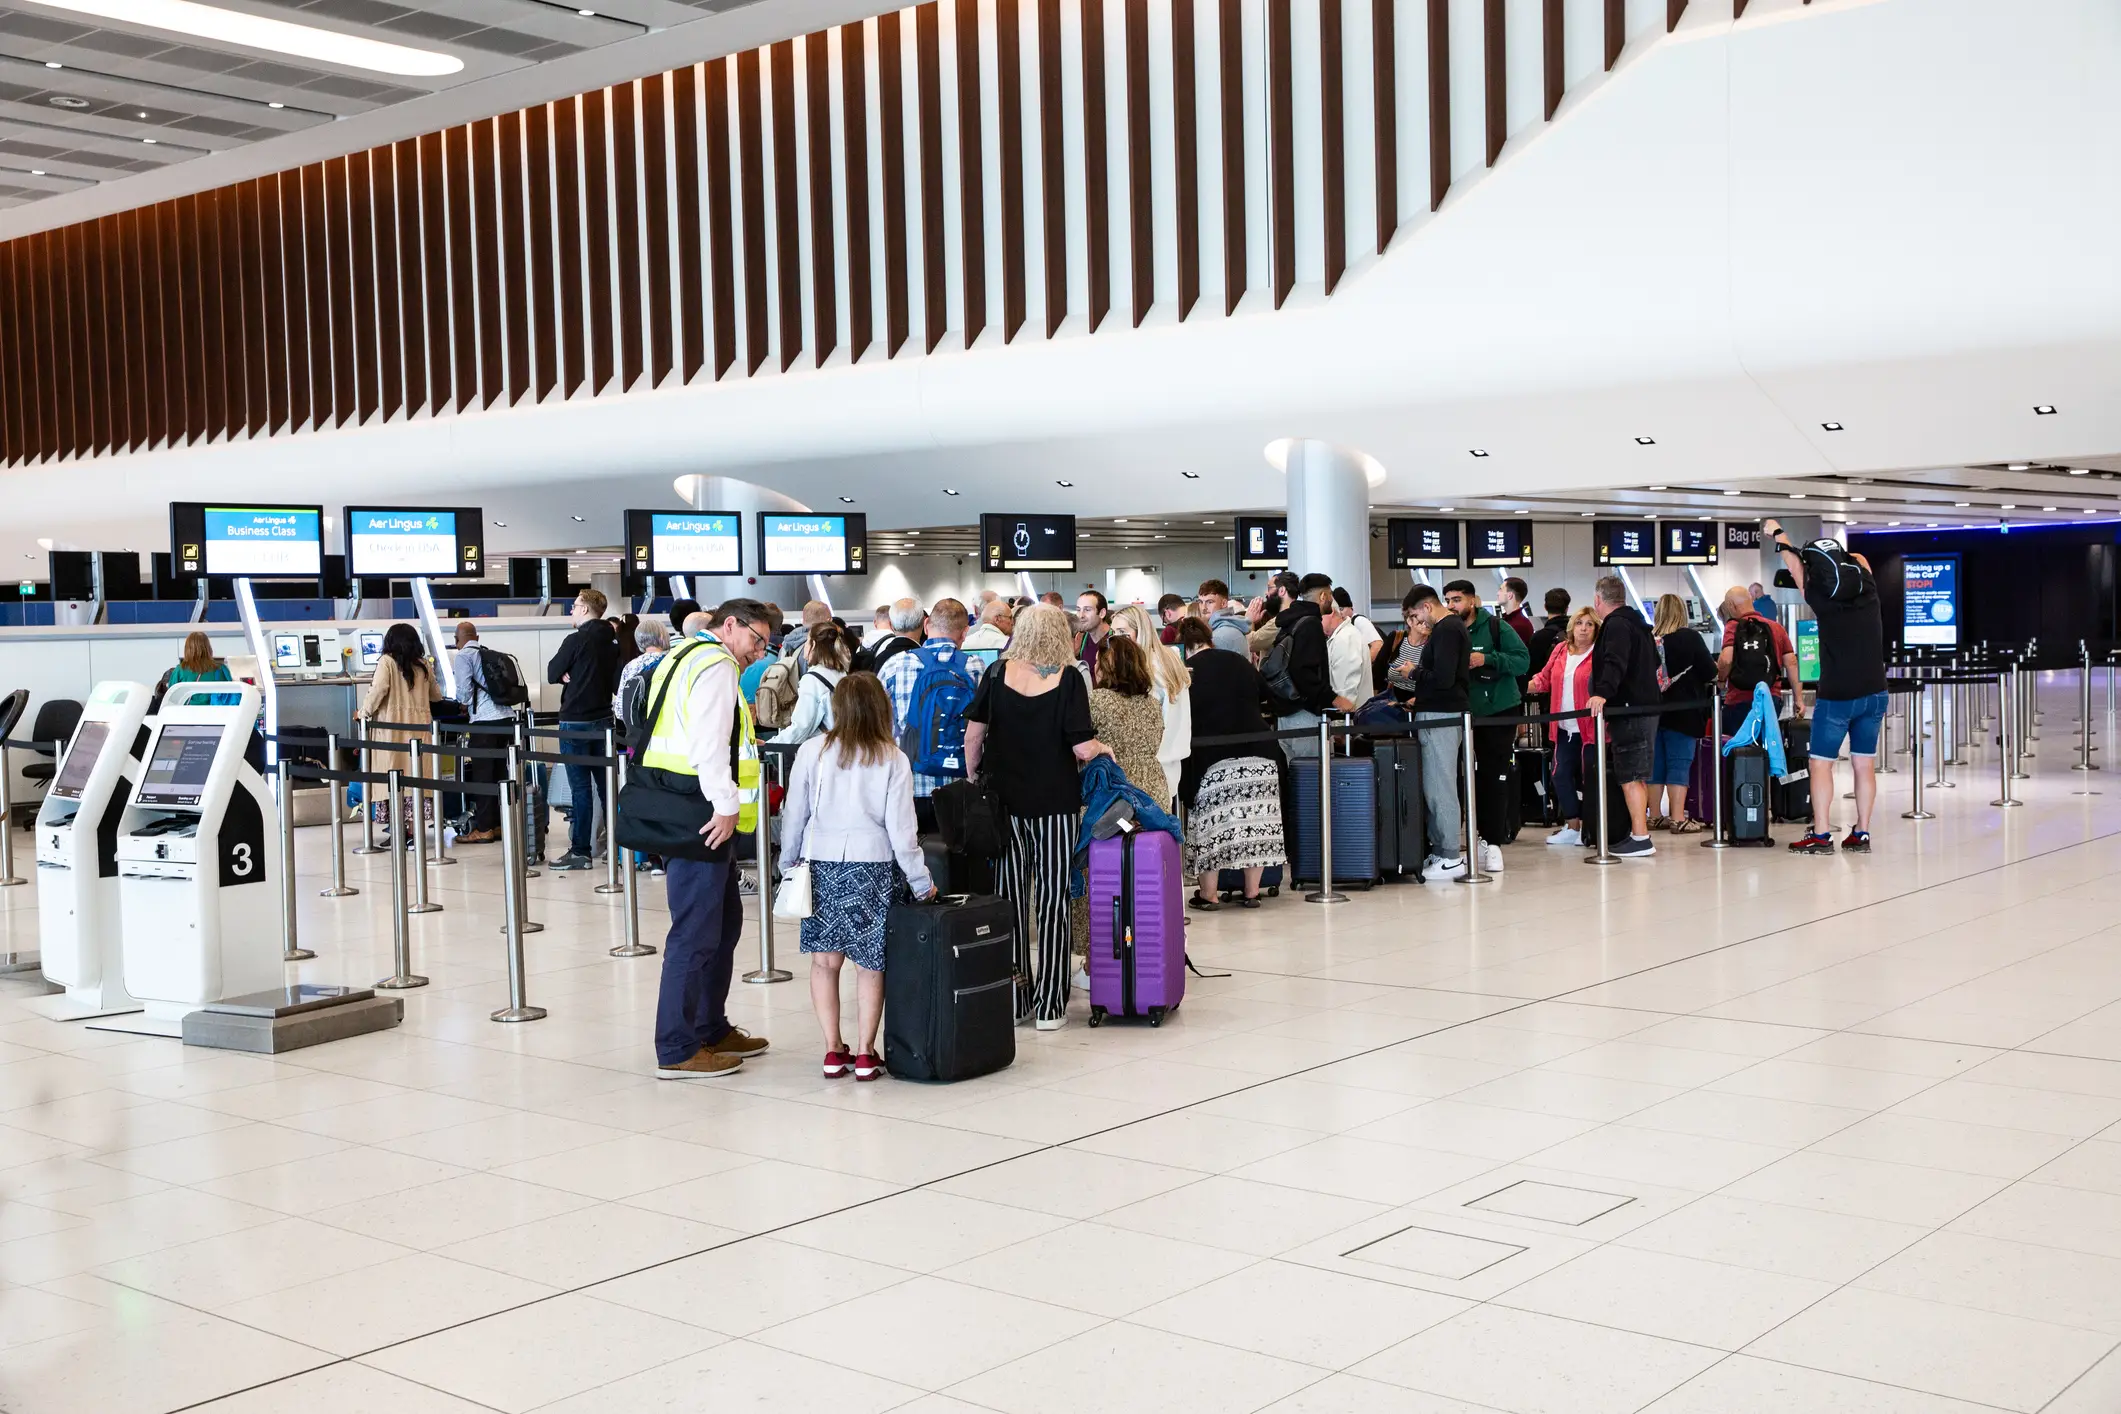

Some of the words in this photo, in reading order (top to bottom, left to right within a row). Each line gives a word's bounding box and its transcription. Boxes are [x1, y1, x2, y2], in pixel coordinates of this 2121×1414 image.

[252, 516, 265, 524] Aer
[266, 516, 286, 525] Lingus
[368, 518, 388, 530] Aer
[389, 518, 423, 532] Lingus
[227, 525, 270, 536] Business
[271, 525, 296, 536] Class
[666, 520, 682, 530] Aer
[682, 520, 711, 534] Lingus
[777, 522, 792, 532] Aer
[792, 522, 820, 534] Lingus
[1728, 528, 1748, 546] Bag
[184, 561, 198, 571] E3
[465, 561, 477, 570] E4
[1906, 564, 1932, 572] Picking
[1906, 580, 1933, 588] STOP!
[231, 842, 253, 876] 3
